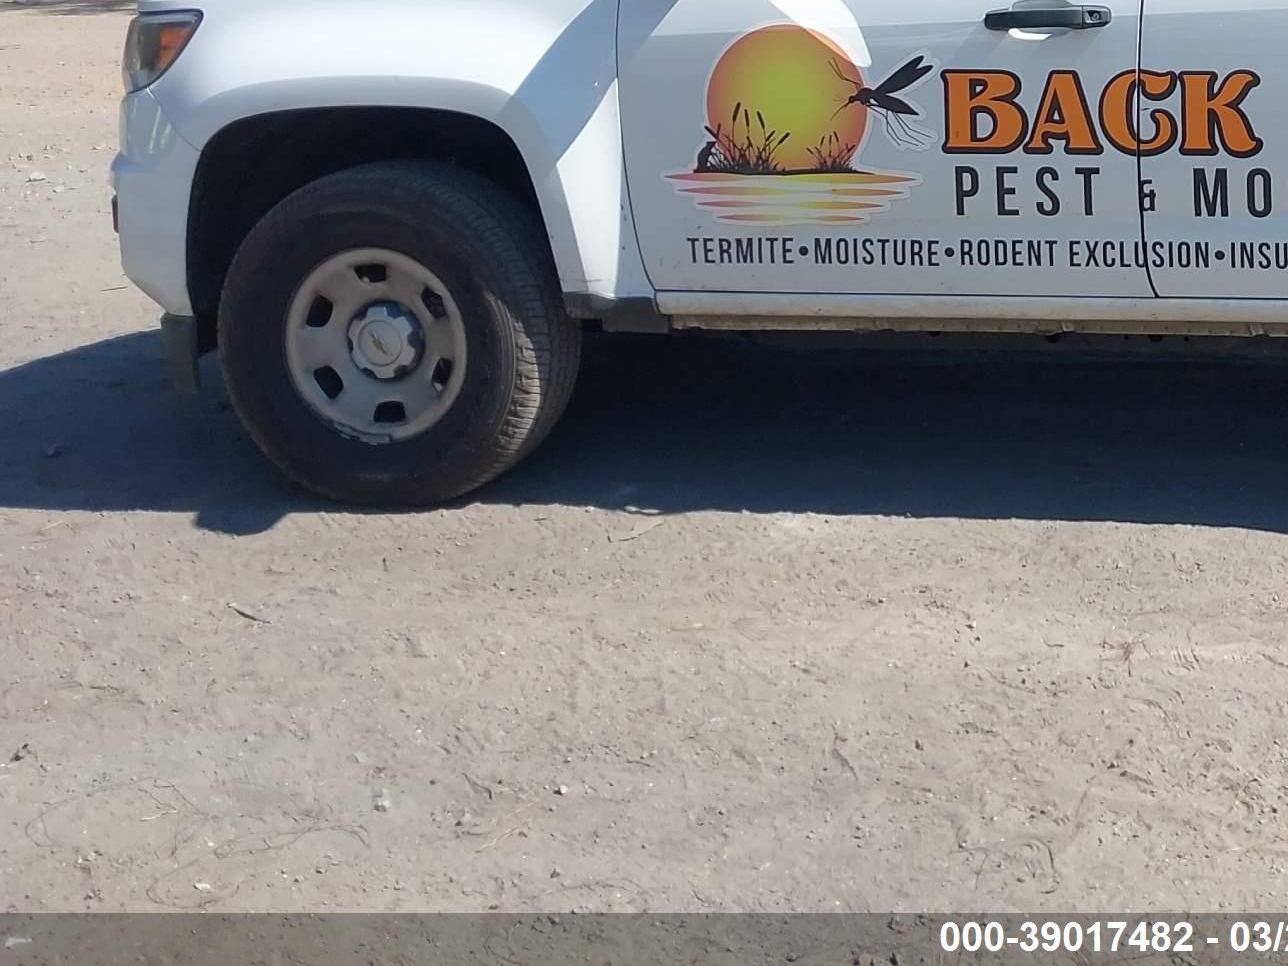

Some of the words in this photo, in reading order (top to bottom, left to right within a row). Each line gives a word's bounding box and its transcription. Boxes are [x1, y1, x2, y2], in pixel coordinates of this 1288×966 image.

[940, 68, 1265, 157] BACK
[955, 165, 1101, 217] PEST
[1140, 179, 1157, 212] &
